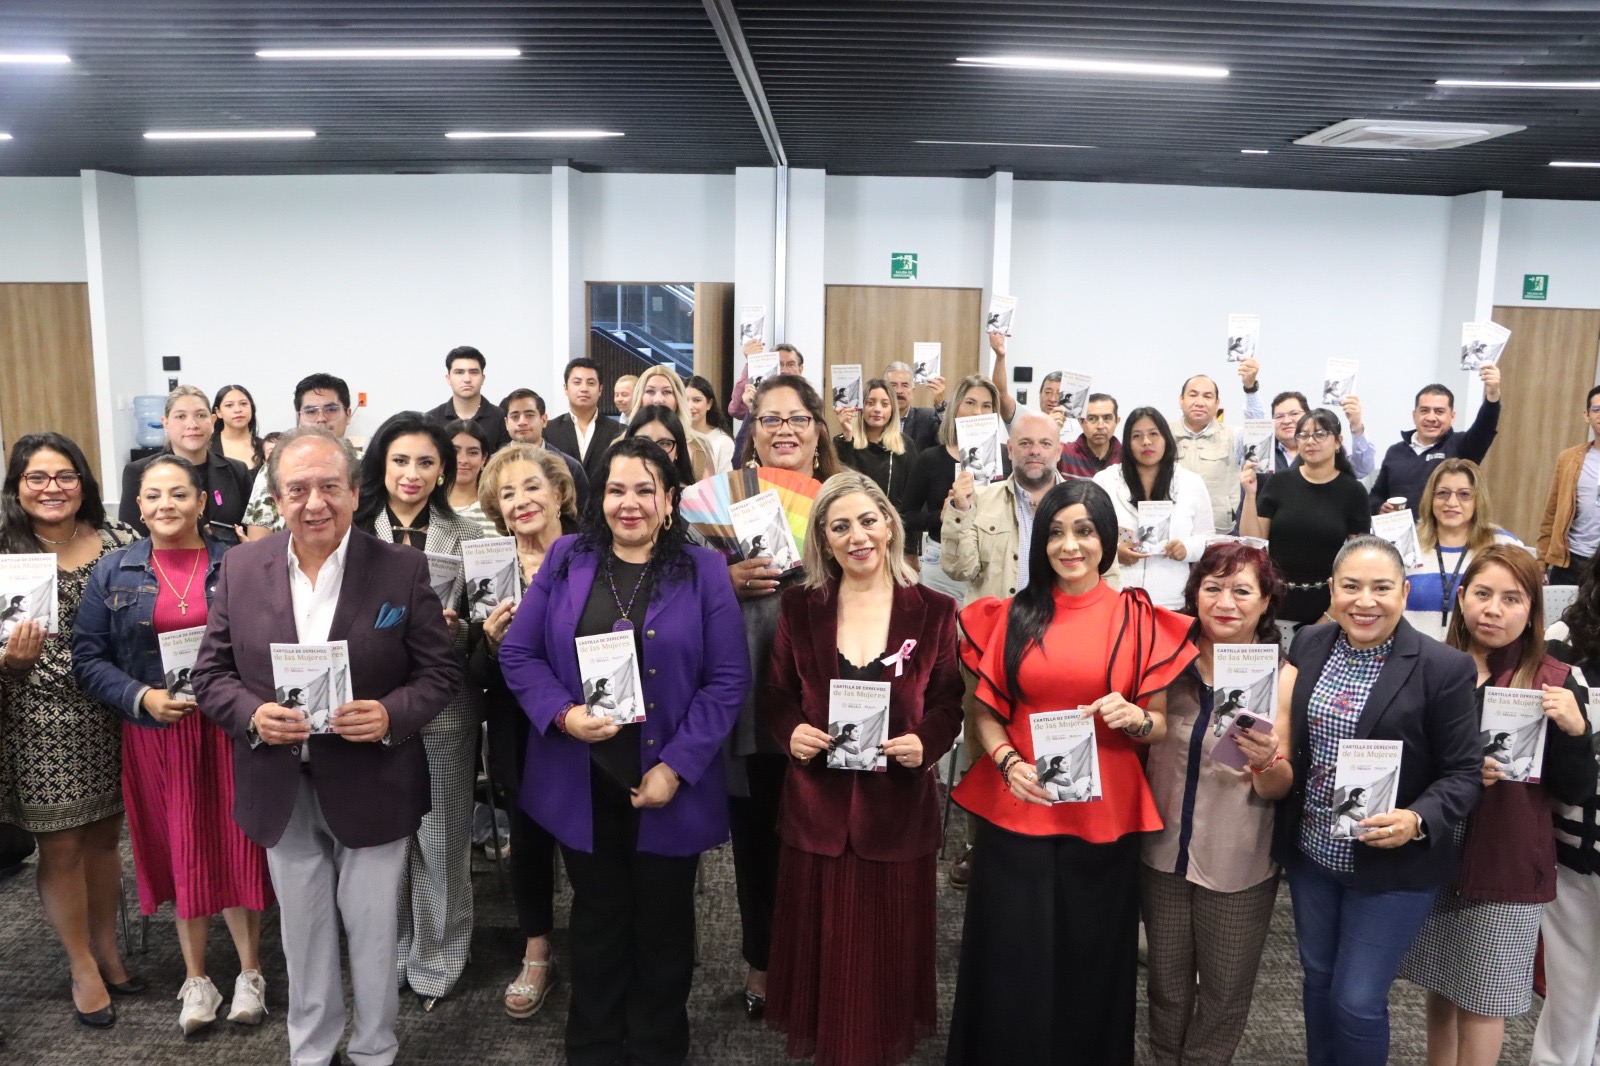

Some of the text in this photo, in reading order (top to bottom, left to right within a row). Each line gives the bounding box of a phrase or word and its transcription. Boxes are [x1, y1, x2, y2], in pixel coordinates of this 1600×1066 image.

[431, 562, 456, 571] Mujeres
[602, 642, 630, 650] Mujeres
[297, 654, 327, 662] Mujeres
[1242, 654, 1274, 662] Mujeres
[856, 691, 886, 699] Mujeres
[1512, 699, 1542, 707] Mujere
[1058, 720, 1090, 728] Mujeres
[1367, 751, 1398, 759] Mujeres
